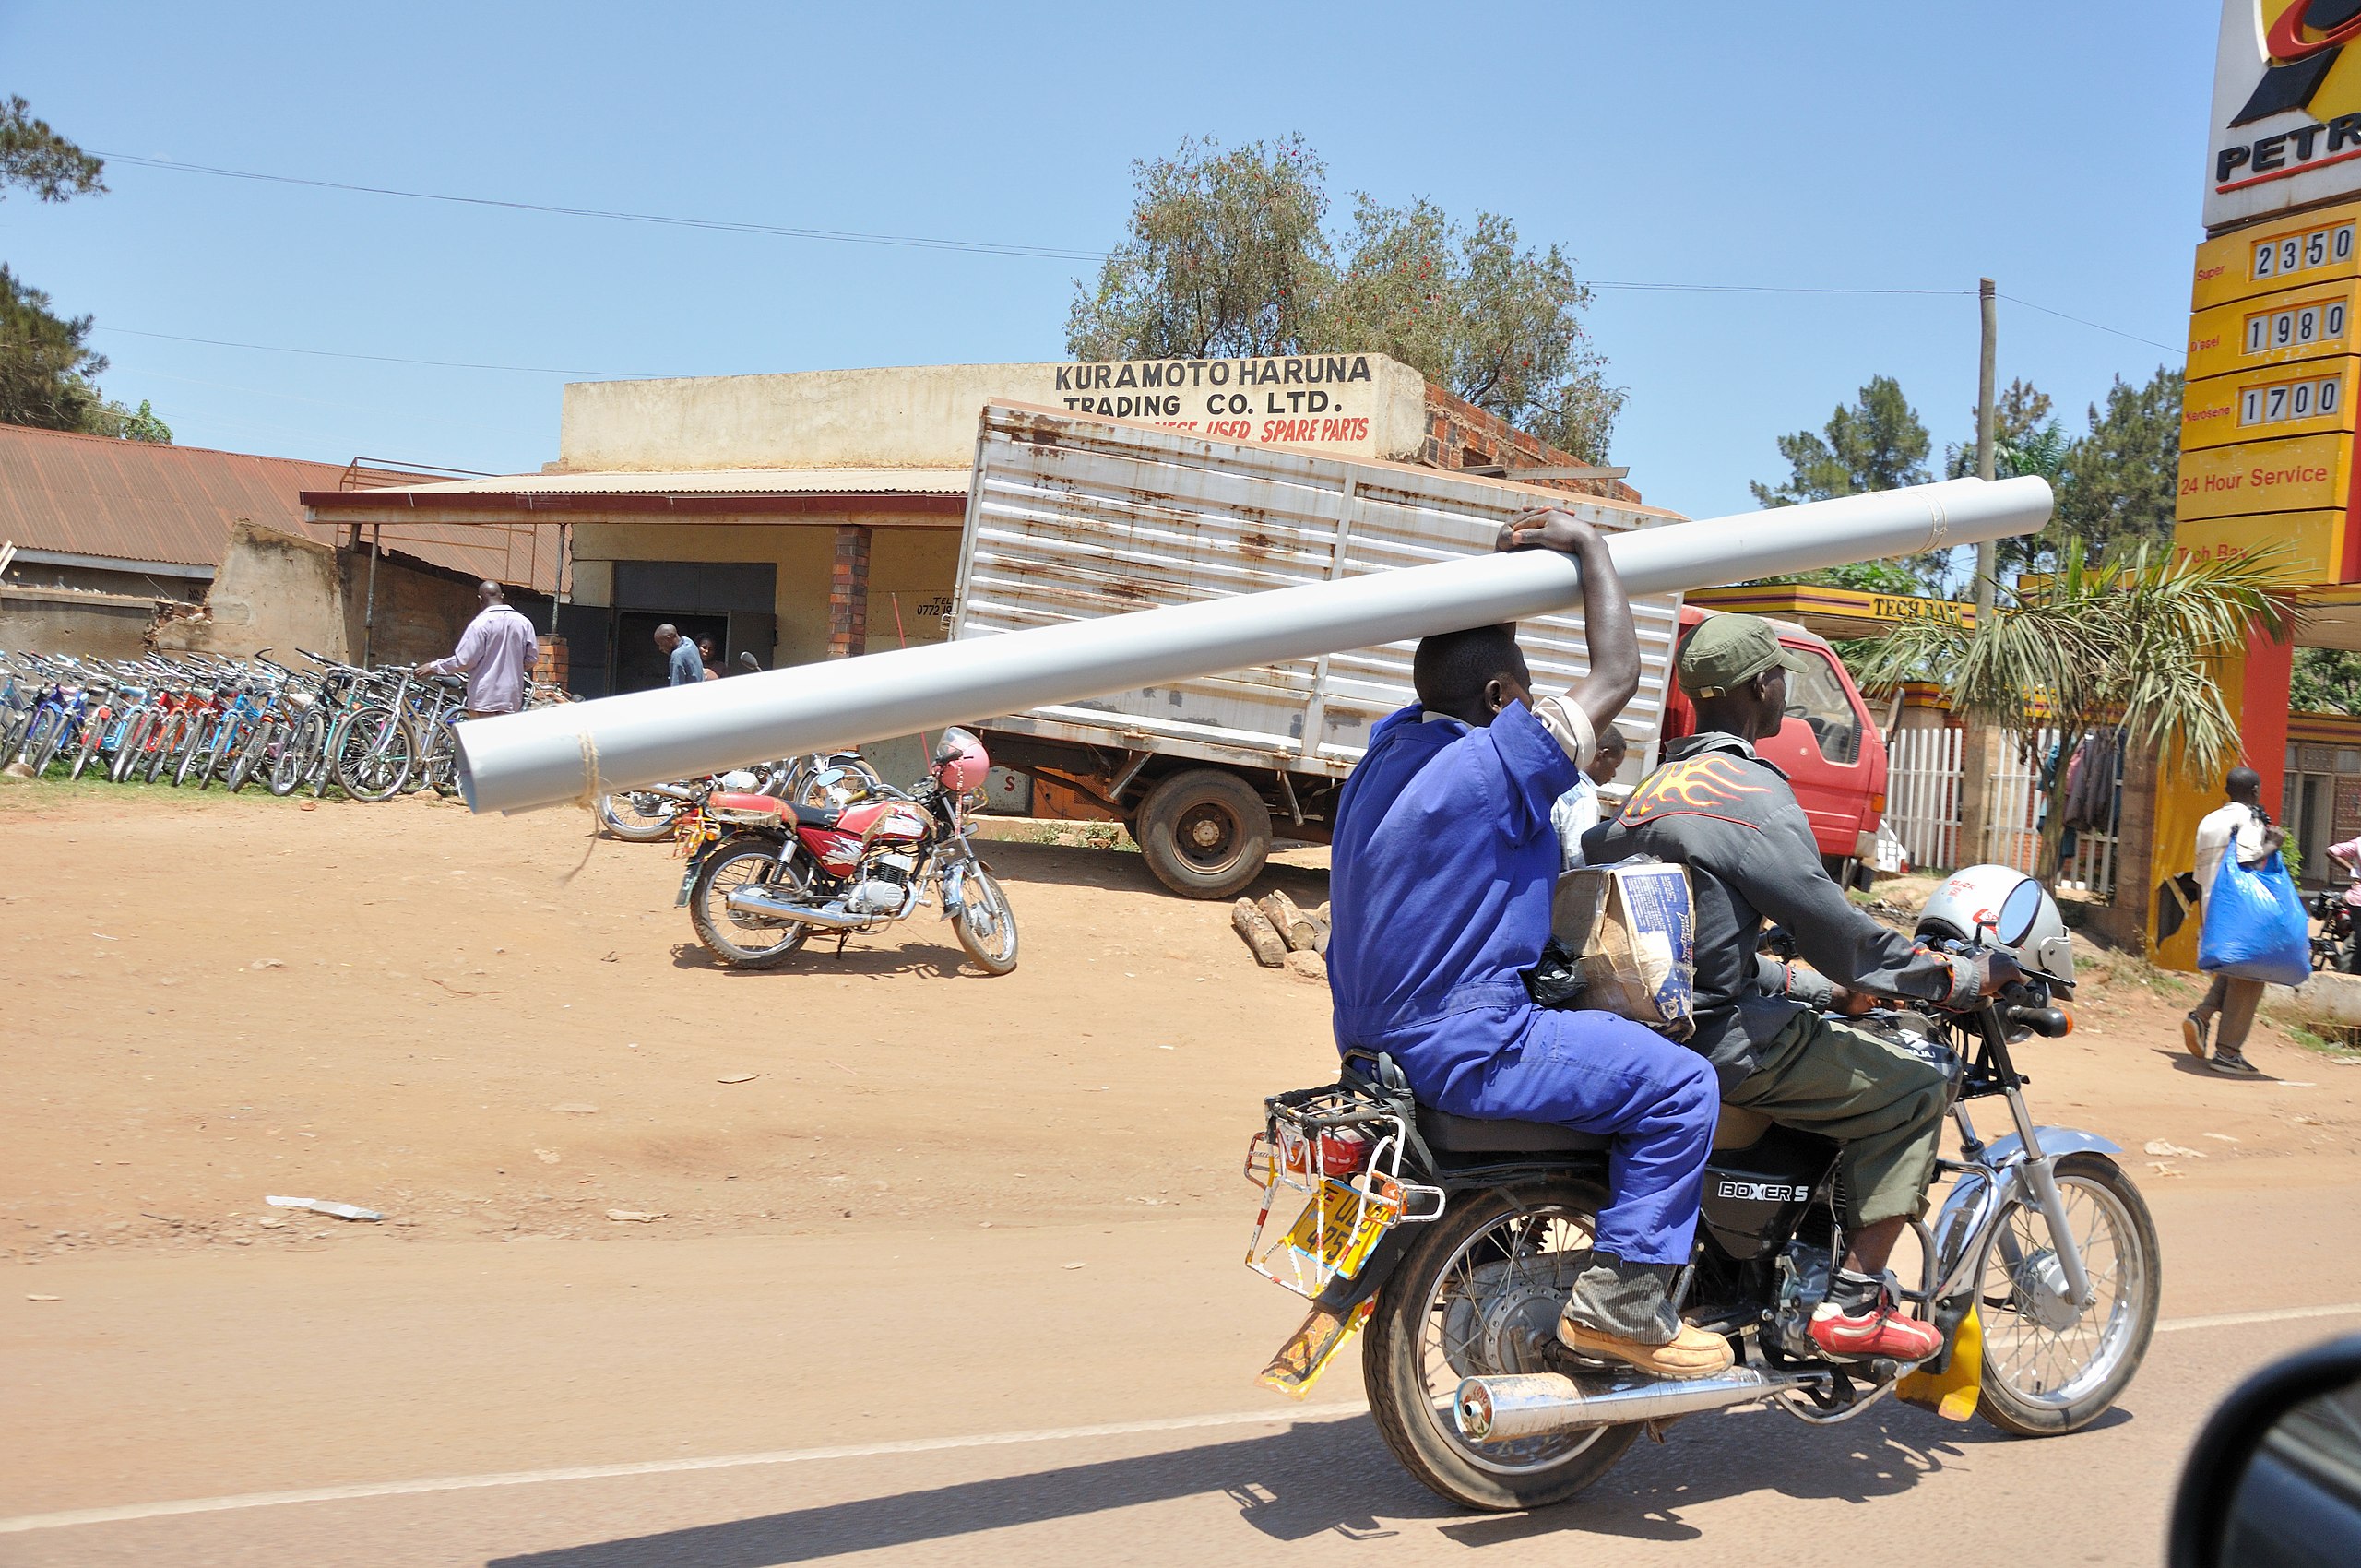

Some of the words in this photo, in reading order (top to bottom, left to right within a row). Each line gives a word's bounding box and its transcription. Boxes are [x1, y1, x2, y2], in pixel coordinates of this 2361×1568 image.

[2196, 265, 2225, 282] Super
[2257, 229, 2350, 275] 2350
[2252, 306, 2343, 349] 1980
[1055, 361, 1233, 391] KURAMOTO
[1239, 356, 1371, 386] HARUNA
[1063, 395, 1180, 418] TRADING
[1206, 393, 1253, 415] CO.
[1267, 390, 1342, 414] LTD.
[2248, 383, 2335, 420] 1700
[1206, 420, 1252, 440] USED
[1261, 418, 1320, 443] SPARE
[1320, 417, 1370, 442] PARTS
[2180, 477, 2199, 496] 24
[2204, 474, 2243, 493] Hour
[2250, 465, 2328, 488] Service
[1874, 598, 1920, 617] TECH
[1718, 1181, 1792, 1202] BOXER
[1794, 1185, 1809, 1202] S
